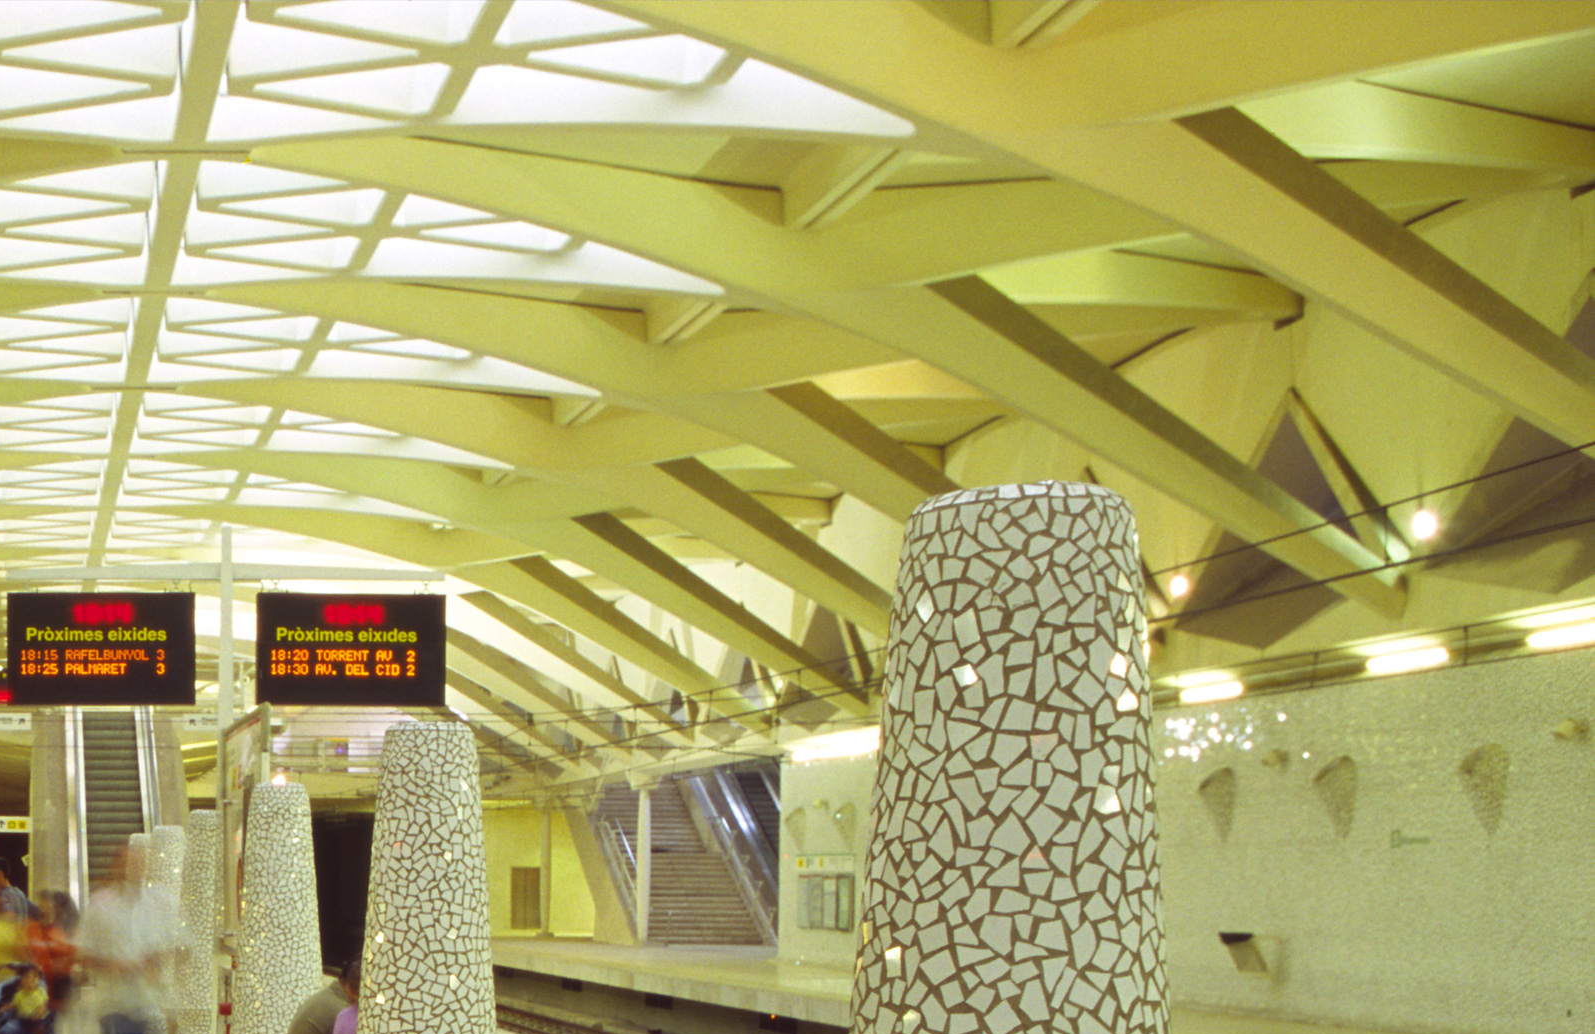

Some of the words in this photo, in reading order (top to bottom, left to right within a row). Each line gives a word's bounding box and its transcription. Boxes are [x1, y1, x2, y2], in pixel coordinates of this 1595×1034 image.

[25, 626, 104, 642] Pròximes
[107, 626, 168, 642] eixides
[275, 626, 355, 643] Pròximes
[357, 627, 418, 643] eixides
[20, 649, 59, 661] 18:15
[64, 649, 150, 661] RAFELBUNYOL
[156, 649, 166, 661] 3
[270, 649, 310, 661] 18:20
[315, 649, 370, 661] TORRENT
[375, 649, 394, 662] AV
[406, 650, 417, 662] 2
[20, 662, 59, 676] 18:25
[64, 662, 128, 676] PALMARET
[156, 662, 166, 676] 3
[270, 662, 310, 676] 18:30
[314, 662, 338, 676] AV.
[344, 663, 370, 676] DEL
[375, 663, 401, 677] CID
[406, 663, 416, 677] 2
